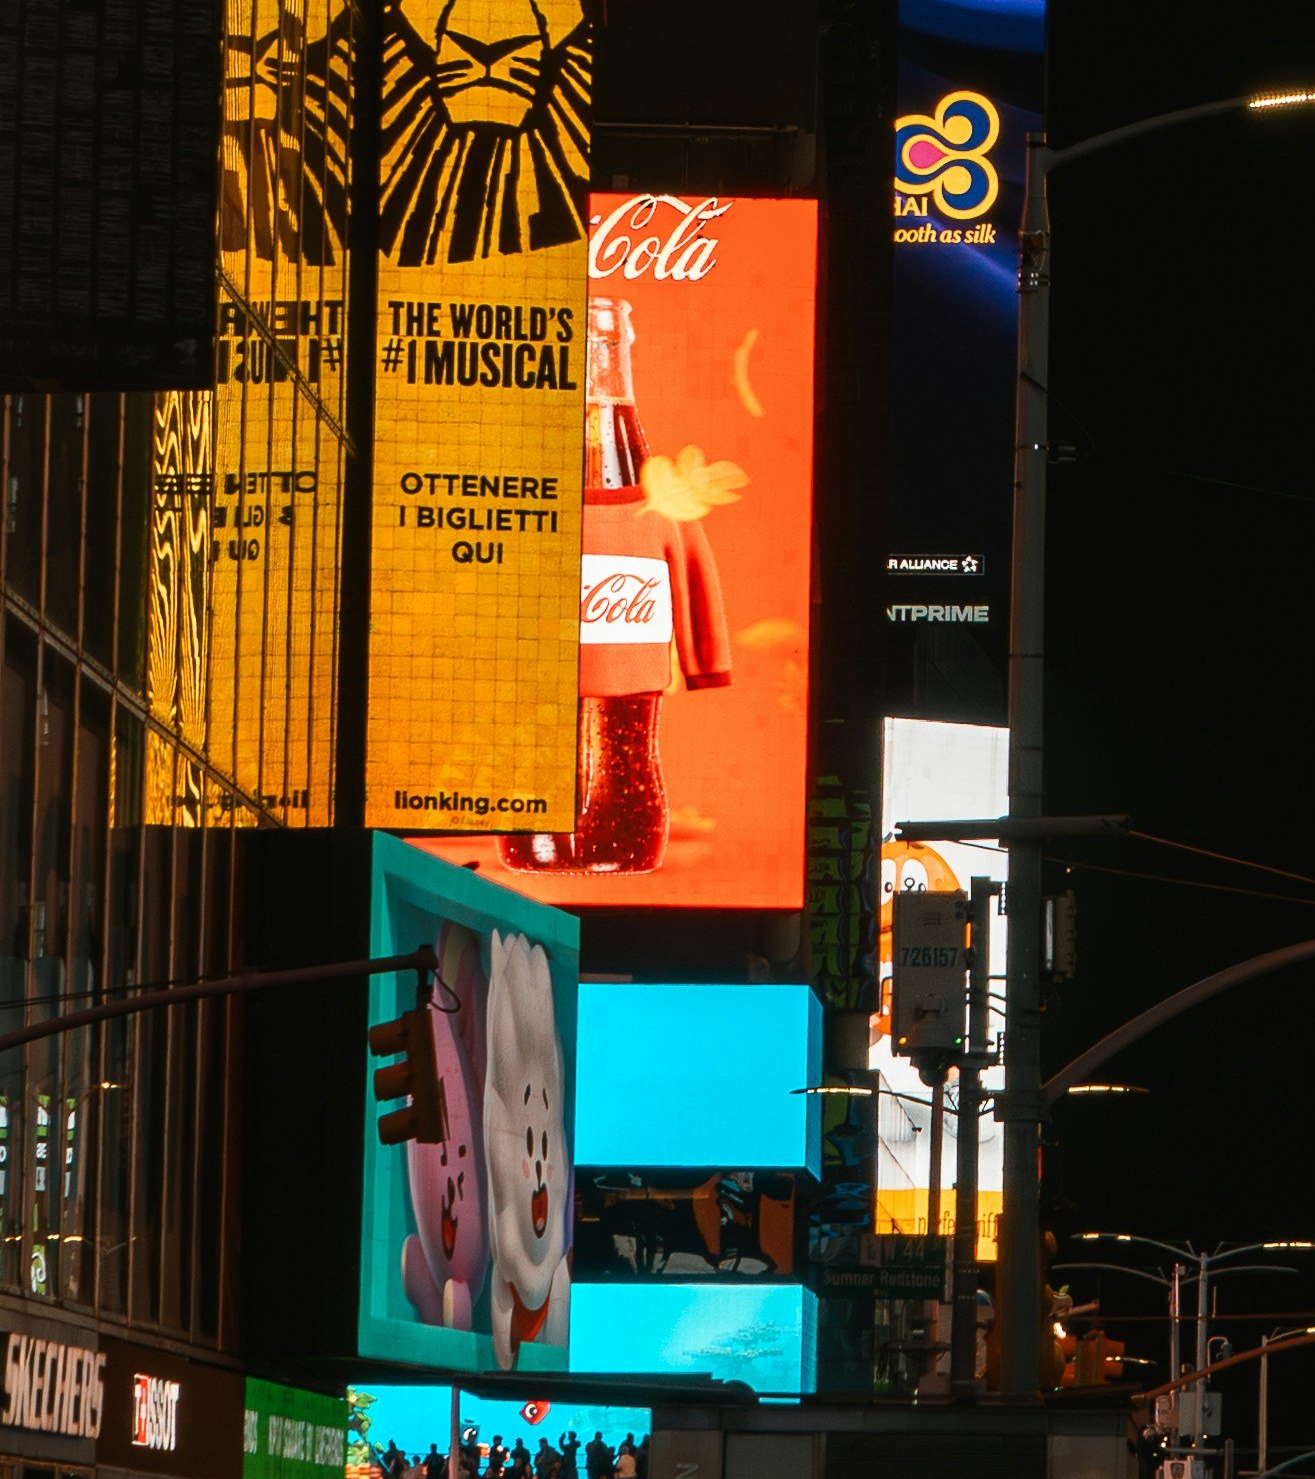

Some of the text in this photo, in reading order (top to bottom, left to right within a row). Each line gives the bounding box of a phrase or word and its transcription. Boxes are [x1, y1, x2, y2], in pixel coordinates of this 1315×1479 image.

[939, 229, 963, 244] as
[963, 223, 997, 244] silk
[388, 300, 574, 341] THE WORLD'S
[424, 341, 578, 391] MUSICAL
[400, 472, 558, 501] OTTENERE
[399, 505, 558, 534] I BIGLIETTI
[451, 540, 504, 565] QUI
[900, 559, 959, 571] ALLIANCE
[395, 790, 548, 816] lionking.com
[900, 946, 959, 968] 726157
[2, 1333, 107, 1440] SKECHERS
